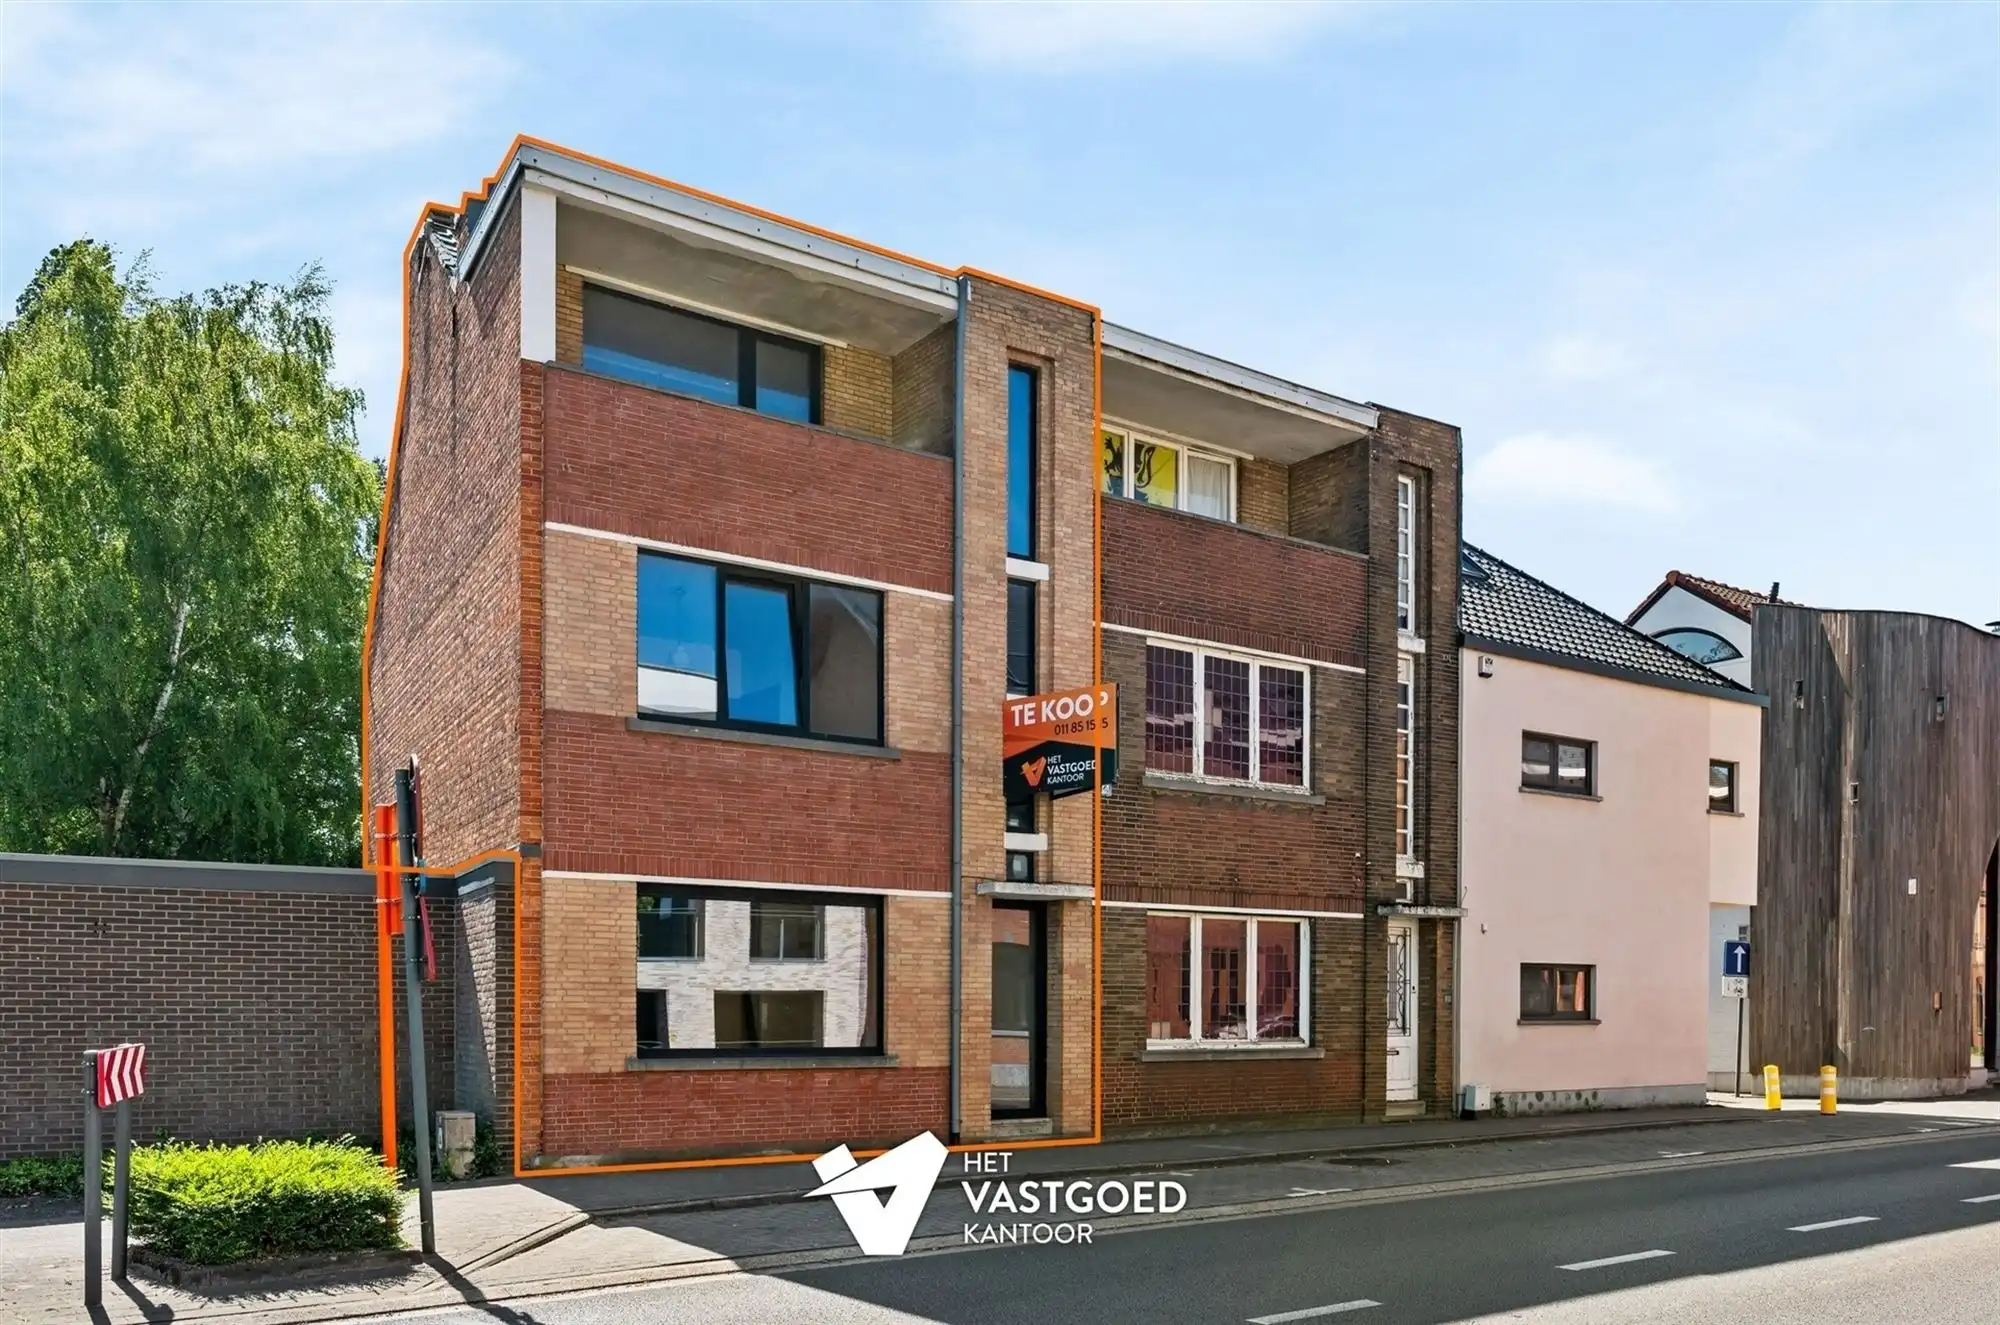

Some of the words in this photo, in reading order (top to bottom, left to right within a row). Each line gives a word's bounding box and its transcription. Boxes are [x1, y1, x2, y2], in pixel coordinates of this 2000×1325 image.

[1011, 702, 1036, 726] TE
[1054, 723, 1069, 735] 011
[1071, 721, 1084, 733] 85
[1086, 720, 1096, 731] 15
[1047, 755, 1062, 765] HET
[1047, 773, 1085, 785] KANTOOR
